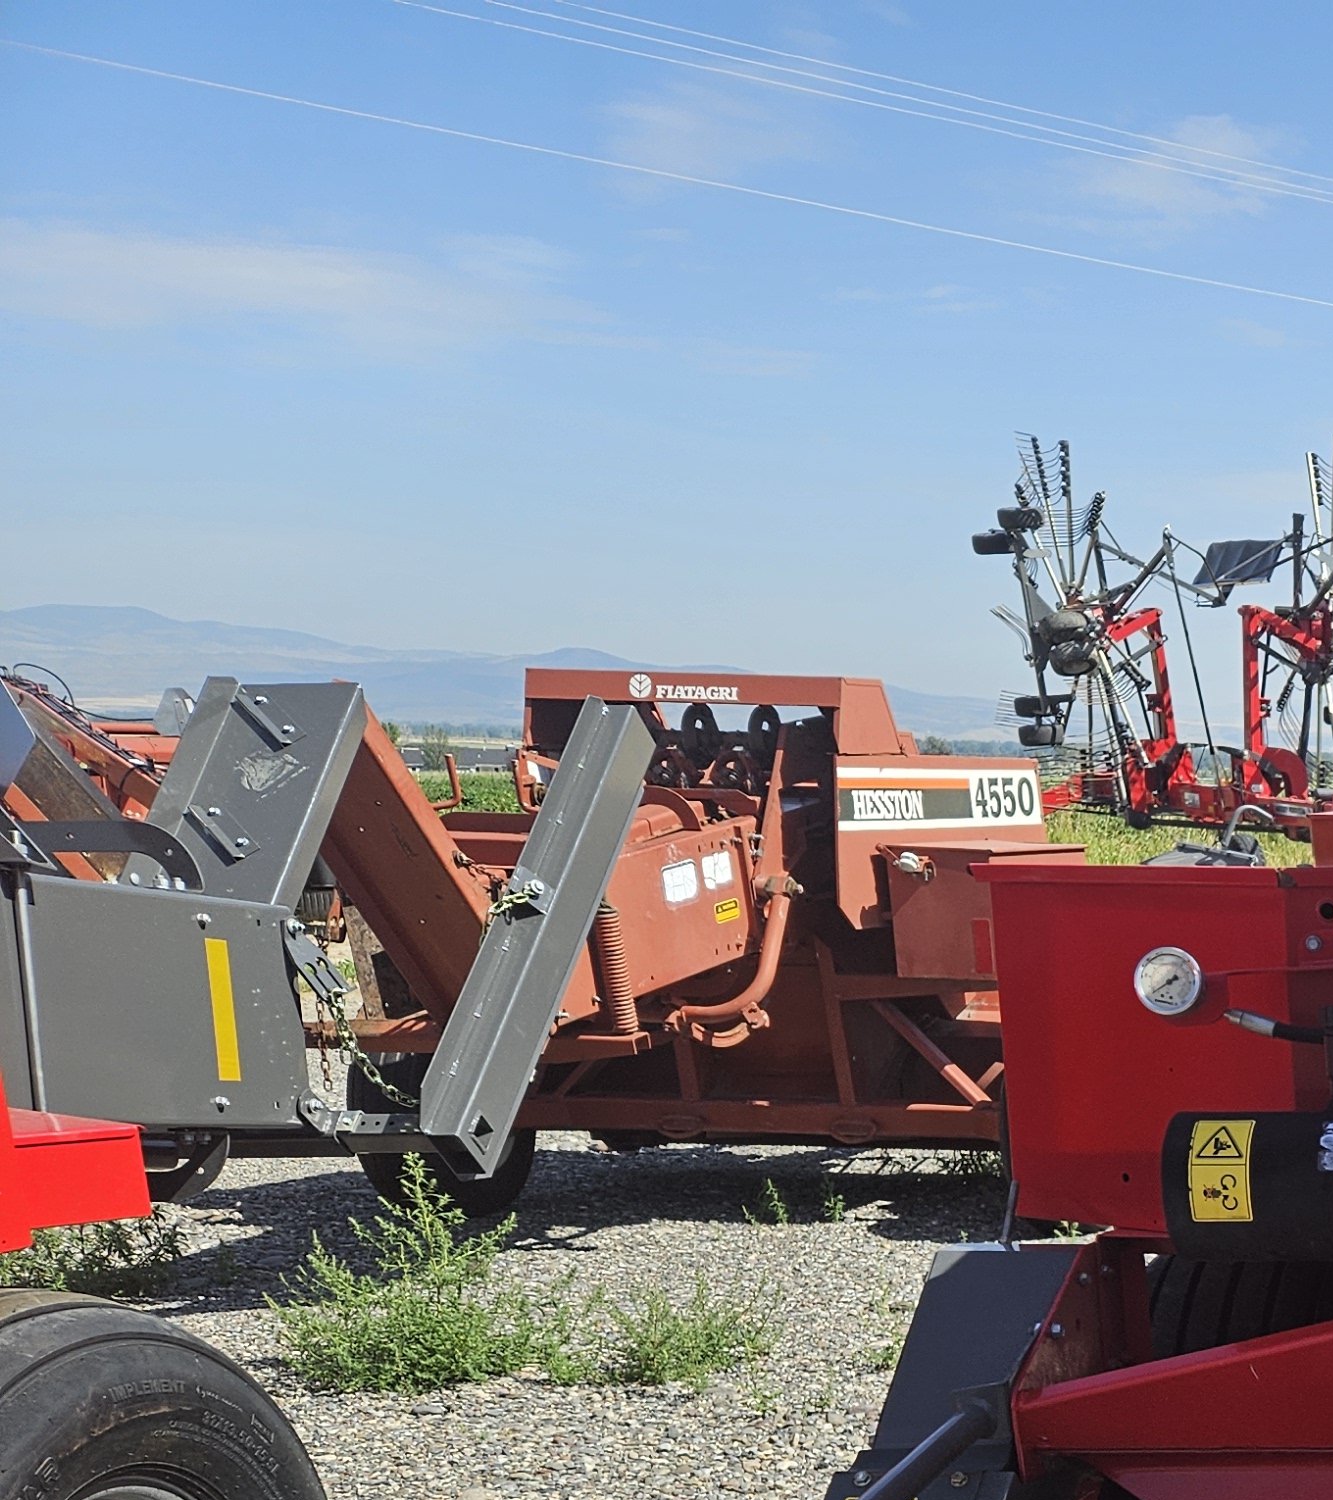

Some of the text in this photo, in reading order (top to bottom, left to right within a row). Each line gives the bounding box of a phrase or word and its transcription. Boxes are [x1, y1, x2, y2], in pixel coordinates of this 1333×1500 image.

[655, 685, 739, 700] FIATAGRI
[851, 789, 924, 820] HESSTON
[975, 777, 1034, 818] 4550
[108, 1378, 187, 1402] IMPLEMENT
